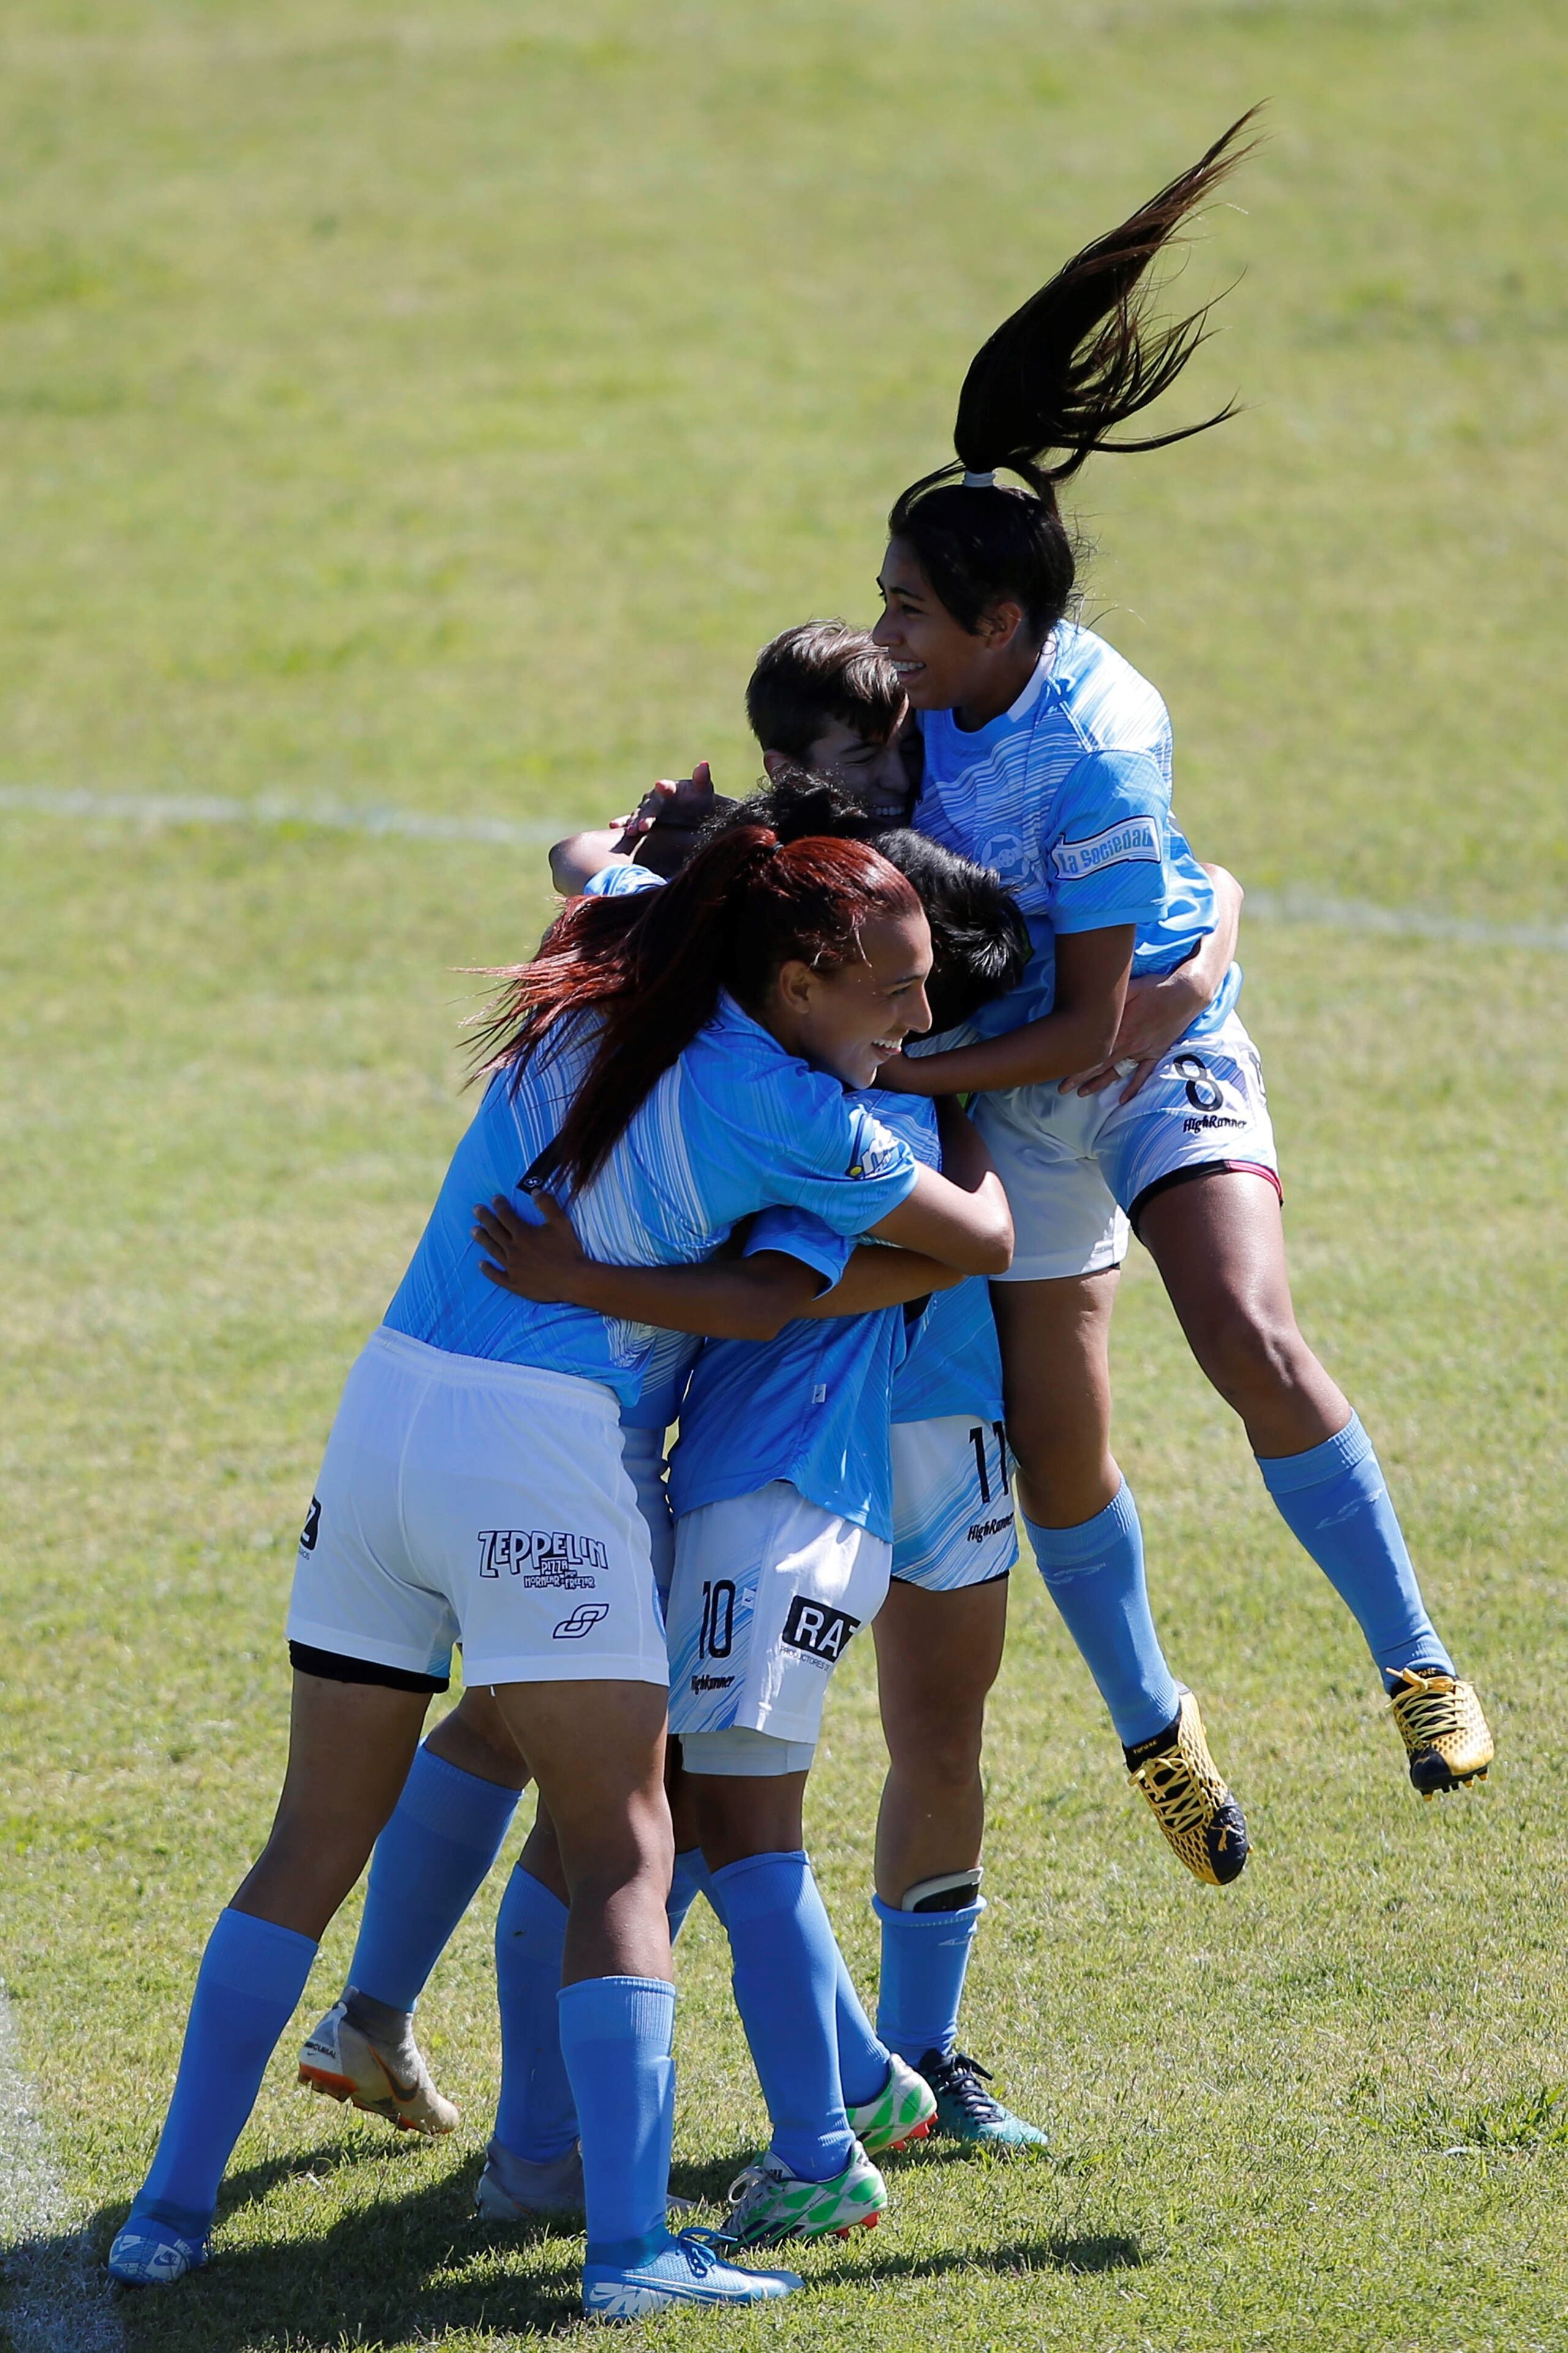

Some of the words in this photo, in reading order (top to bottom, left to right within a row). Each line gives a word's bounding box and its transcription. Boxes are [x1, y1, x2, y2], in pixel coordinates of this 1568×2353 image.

[1057, 853, 1079, 874] La
[1079, 826, 1154, 869] Sociedad
[1172, 1053, 1224, 1112] 8
[969, 1420, 1009, 1504] 11
[478, 1530, 609, 1578] ZEPPELIN
[541, 1560, 568, 1575] PIZZA
[699, 1579, 736, 1660] 10
[304, 2041, 337, 2059] CURIAL
